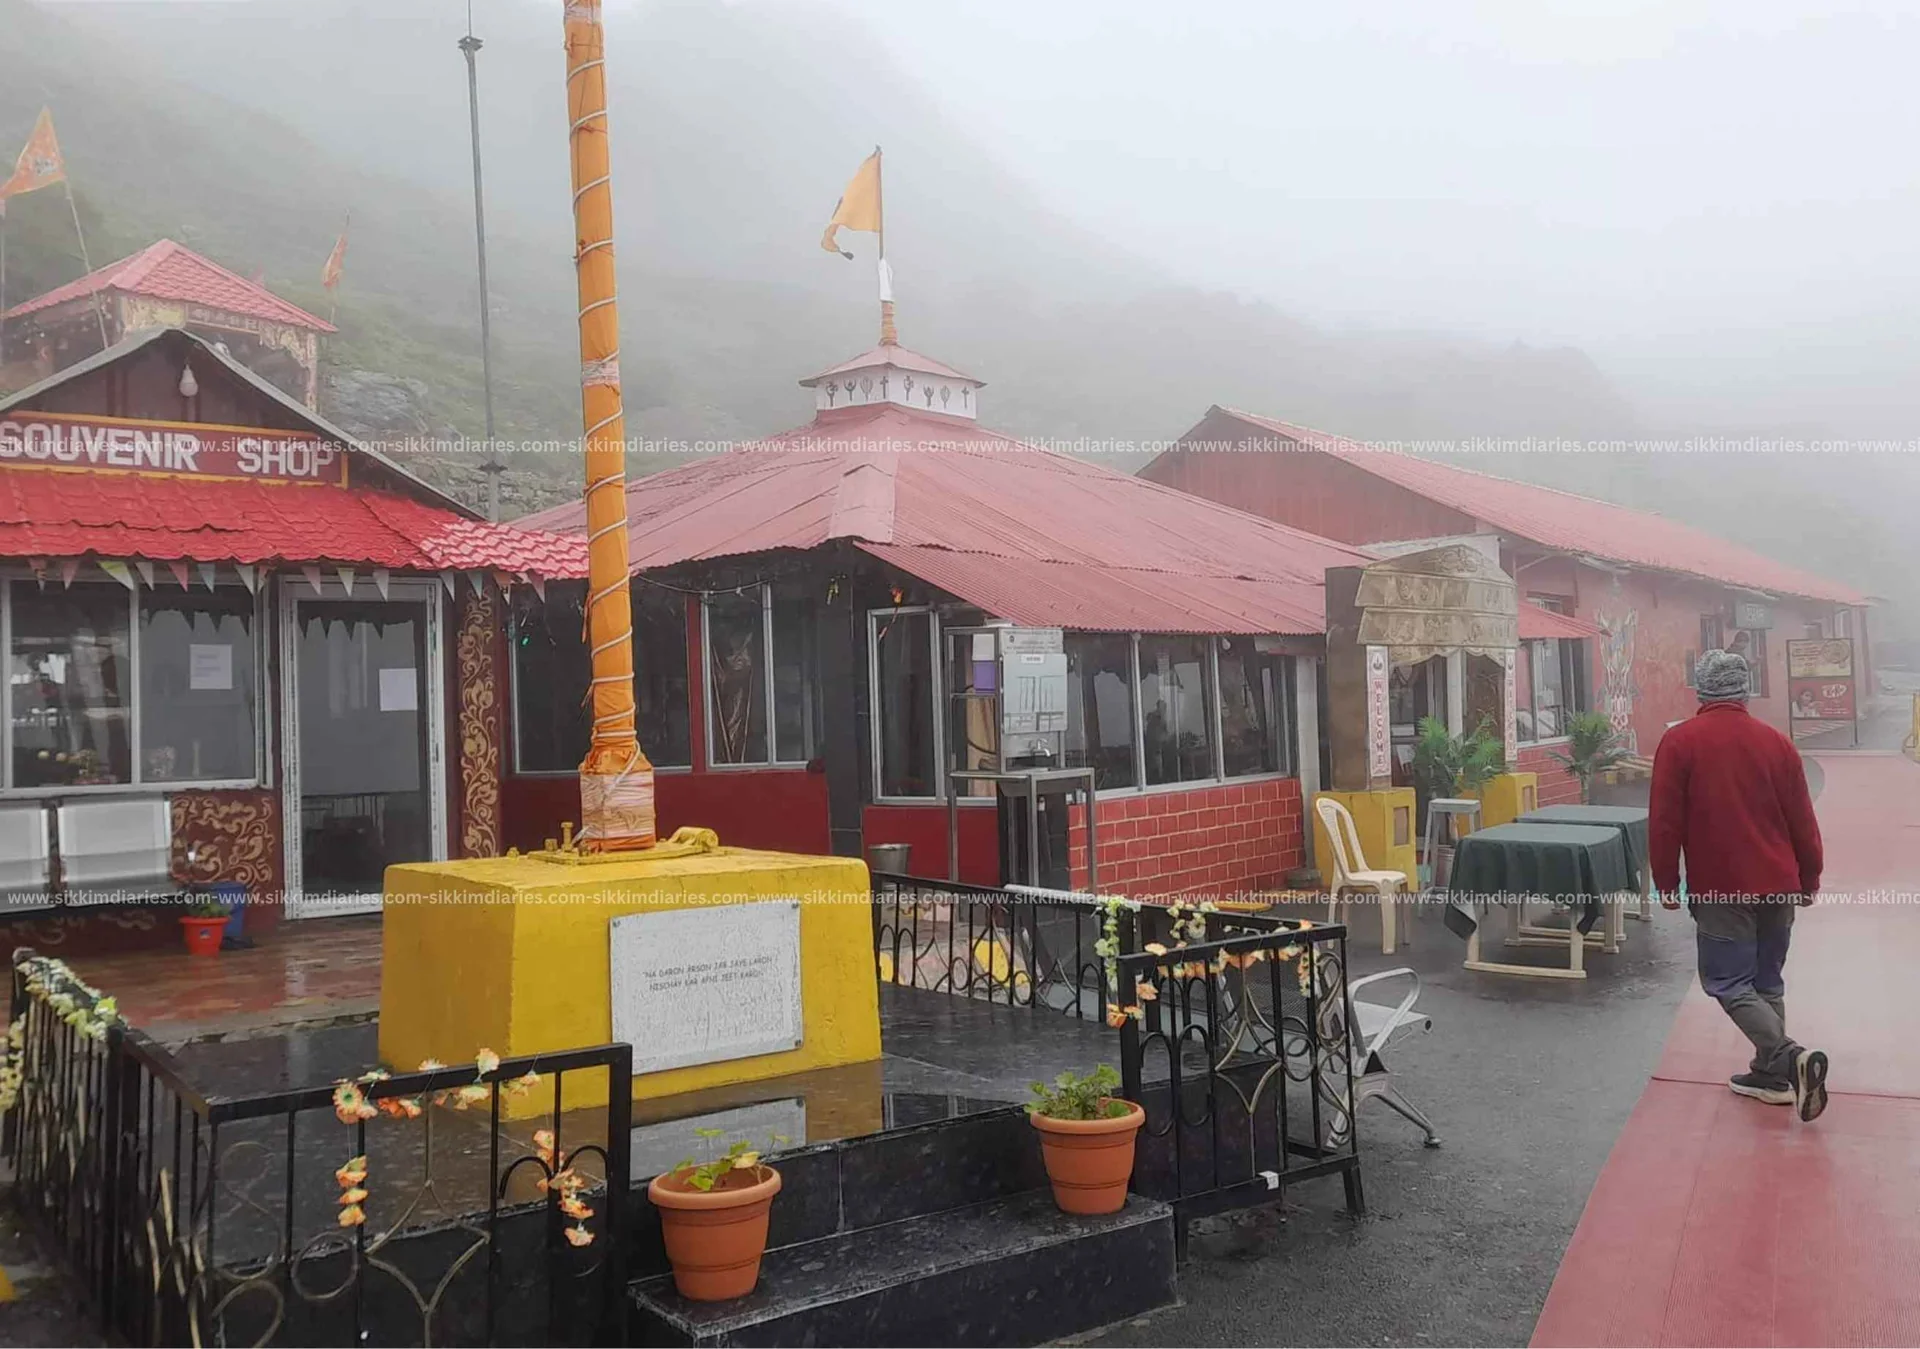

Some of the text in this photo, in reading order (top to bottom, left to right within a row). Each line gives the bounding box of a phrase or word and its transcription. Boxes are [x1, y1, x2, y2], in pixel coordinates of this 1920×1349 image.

[0, 421, 335, 477] SOUVENIR SHOP
[1374, 680, 1385, 765] WELCOME
